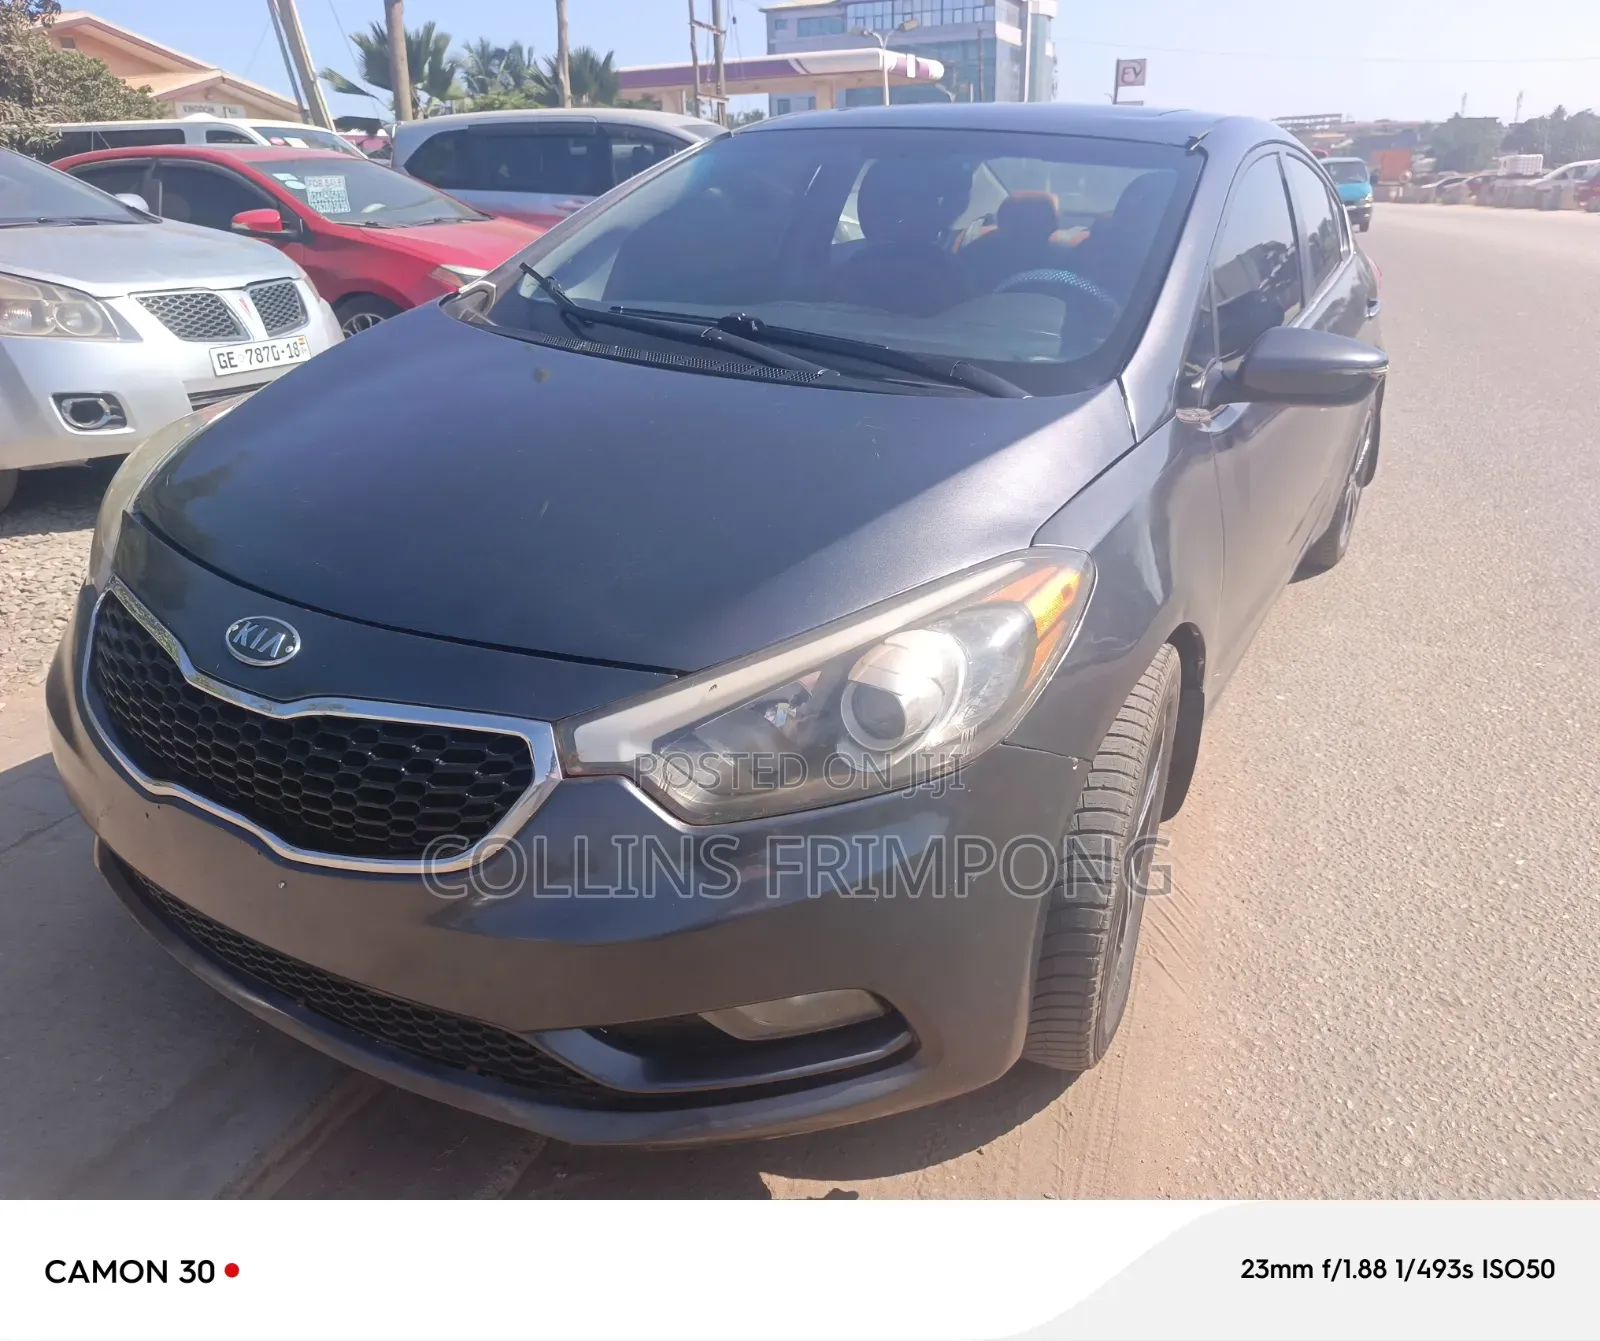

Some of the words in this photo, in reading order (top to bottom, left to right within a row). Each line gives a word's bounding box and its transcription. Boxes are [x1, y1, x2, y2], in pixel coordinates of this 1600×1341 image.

[308, 179, 322, 187] FOR
[325, 178, 343, 187] SALE
[216, 351, 238, 370] GE
[232, 620, 286, 658] KIA
